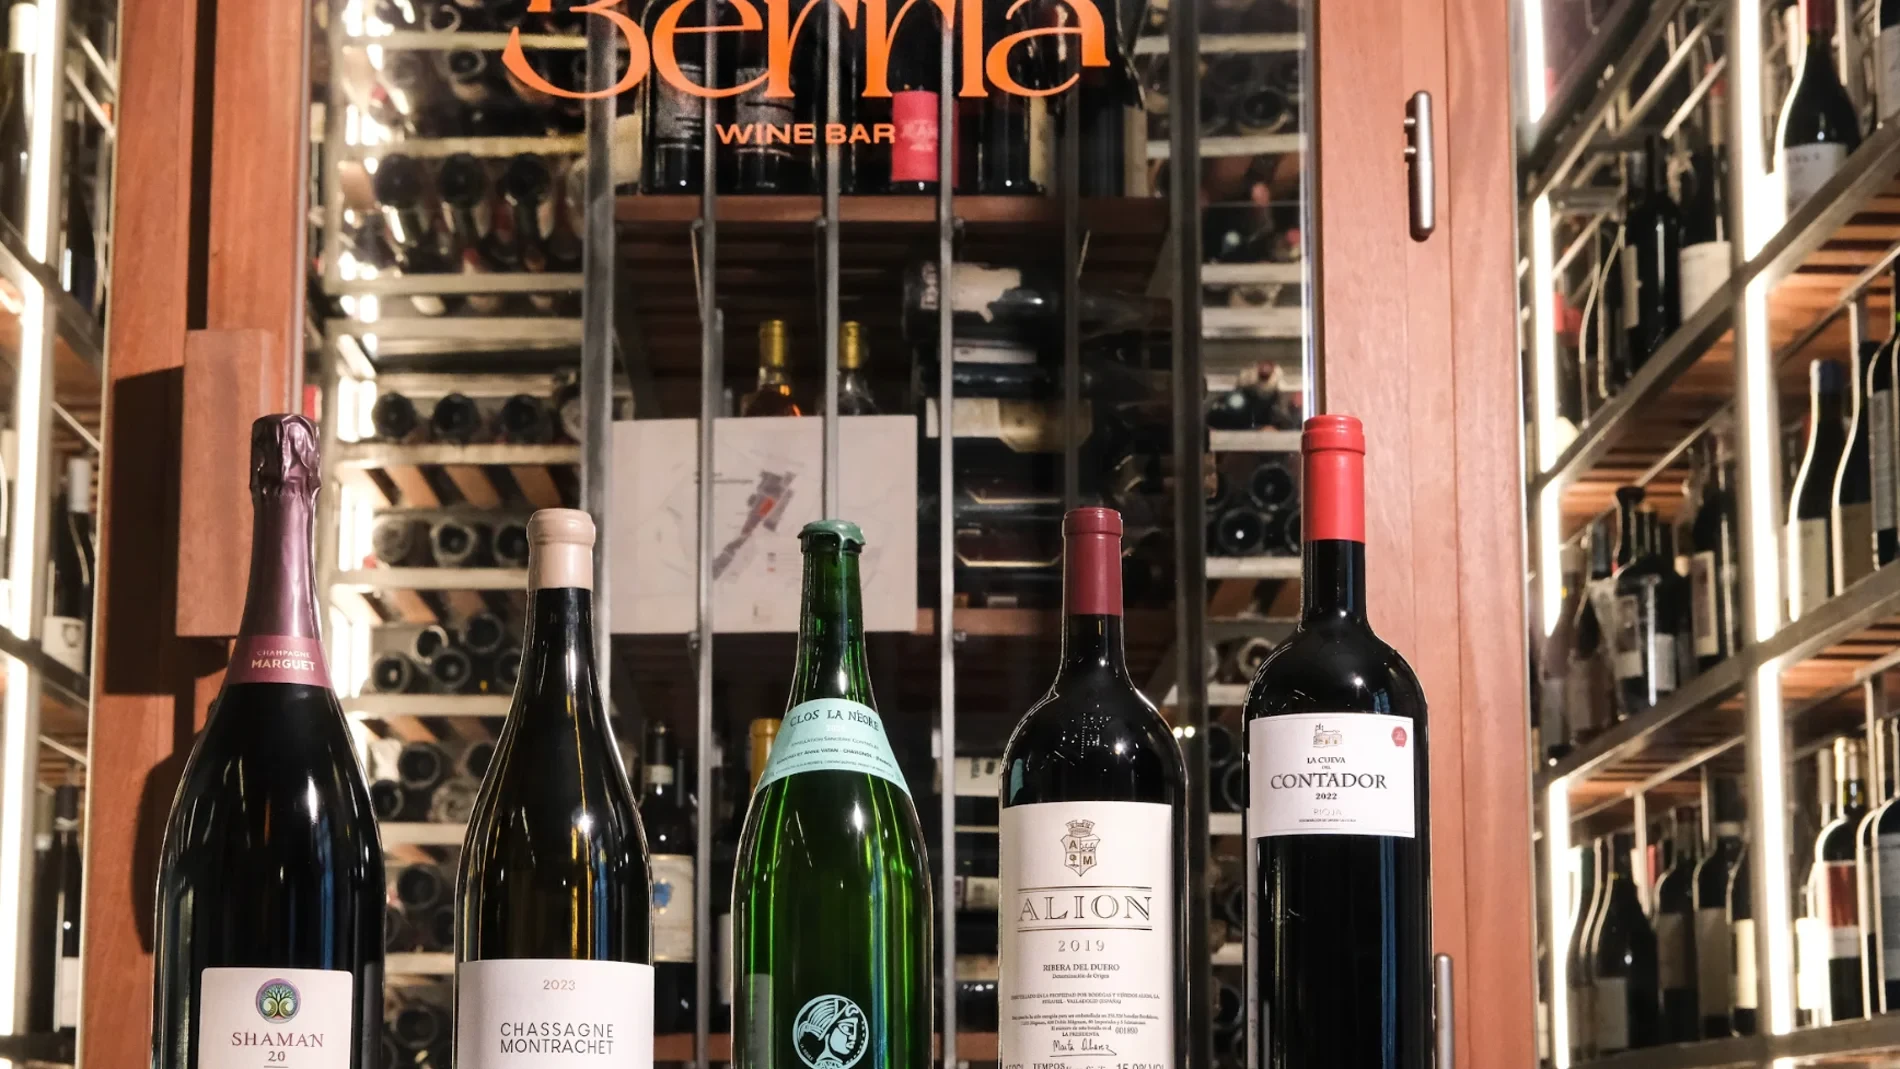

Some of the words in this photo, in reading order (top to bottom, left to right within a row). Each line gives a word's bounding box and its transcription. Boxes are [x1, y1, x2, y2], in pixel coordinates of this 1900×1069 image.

[715, 123, 815, 145] WINE
[825, 123, 897, 145] BAR
[256, 649, 311, 660] CHAMPAGNE
[251, 659, 316, 672] MARGUET
[790, 709, 820, 728] CLOS
[827, 709, 843, 721] LA
[1307, 757, 1317, 765] LA
[1318, 756, 1346, 765] CUEVA
[1270, 772, 1388, 790] CONTADOR
[1315, 792, 1338, 800] 2022
[1068, 839, 1078, 850] A
[1082, 855, 1093, 866] M
[1018, 894, 1152, 921] ALION
[1058, 939, 1105, 953] 2019
[1043, 963, 1071, 972] RIBERA
[1073, 963, 1090, 971] DEL
[1090, 963, 1120, 971] DUERO
[543, 979, 576, 991] 2023
[500, 1022, 614, 1038] CHASSAGNE
[231, 1032, 324, 1048] SHAMAN
[500, 1038, 614, 1055] MONTRACHET
[268, 1051, 286, 1062] 20
